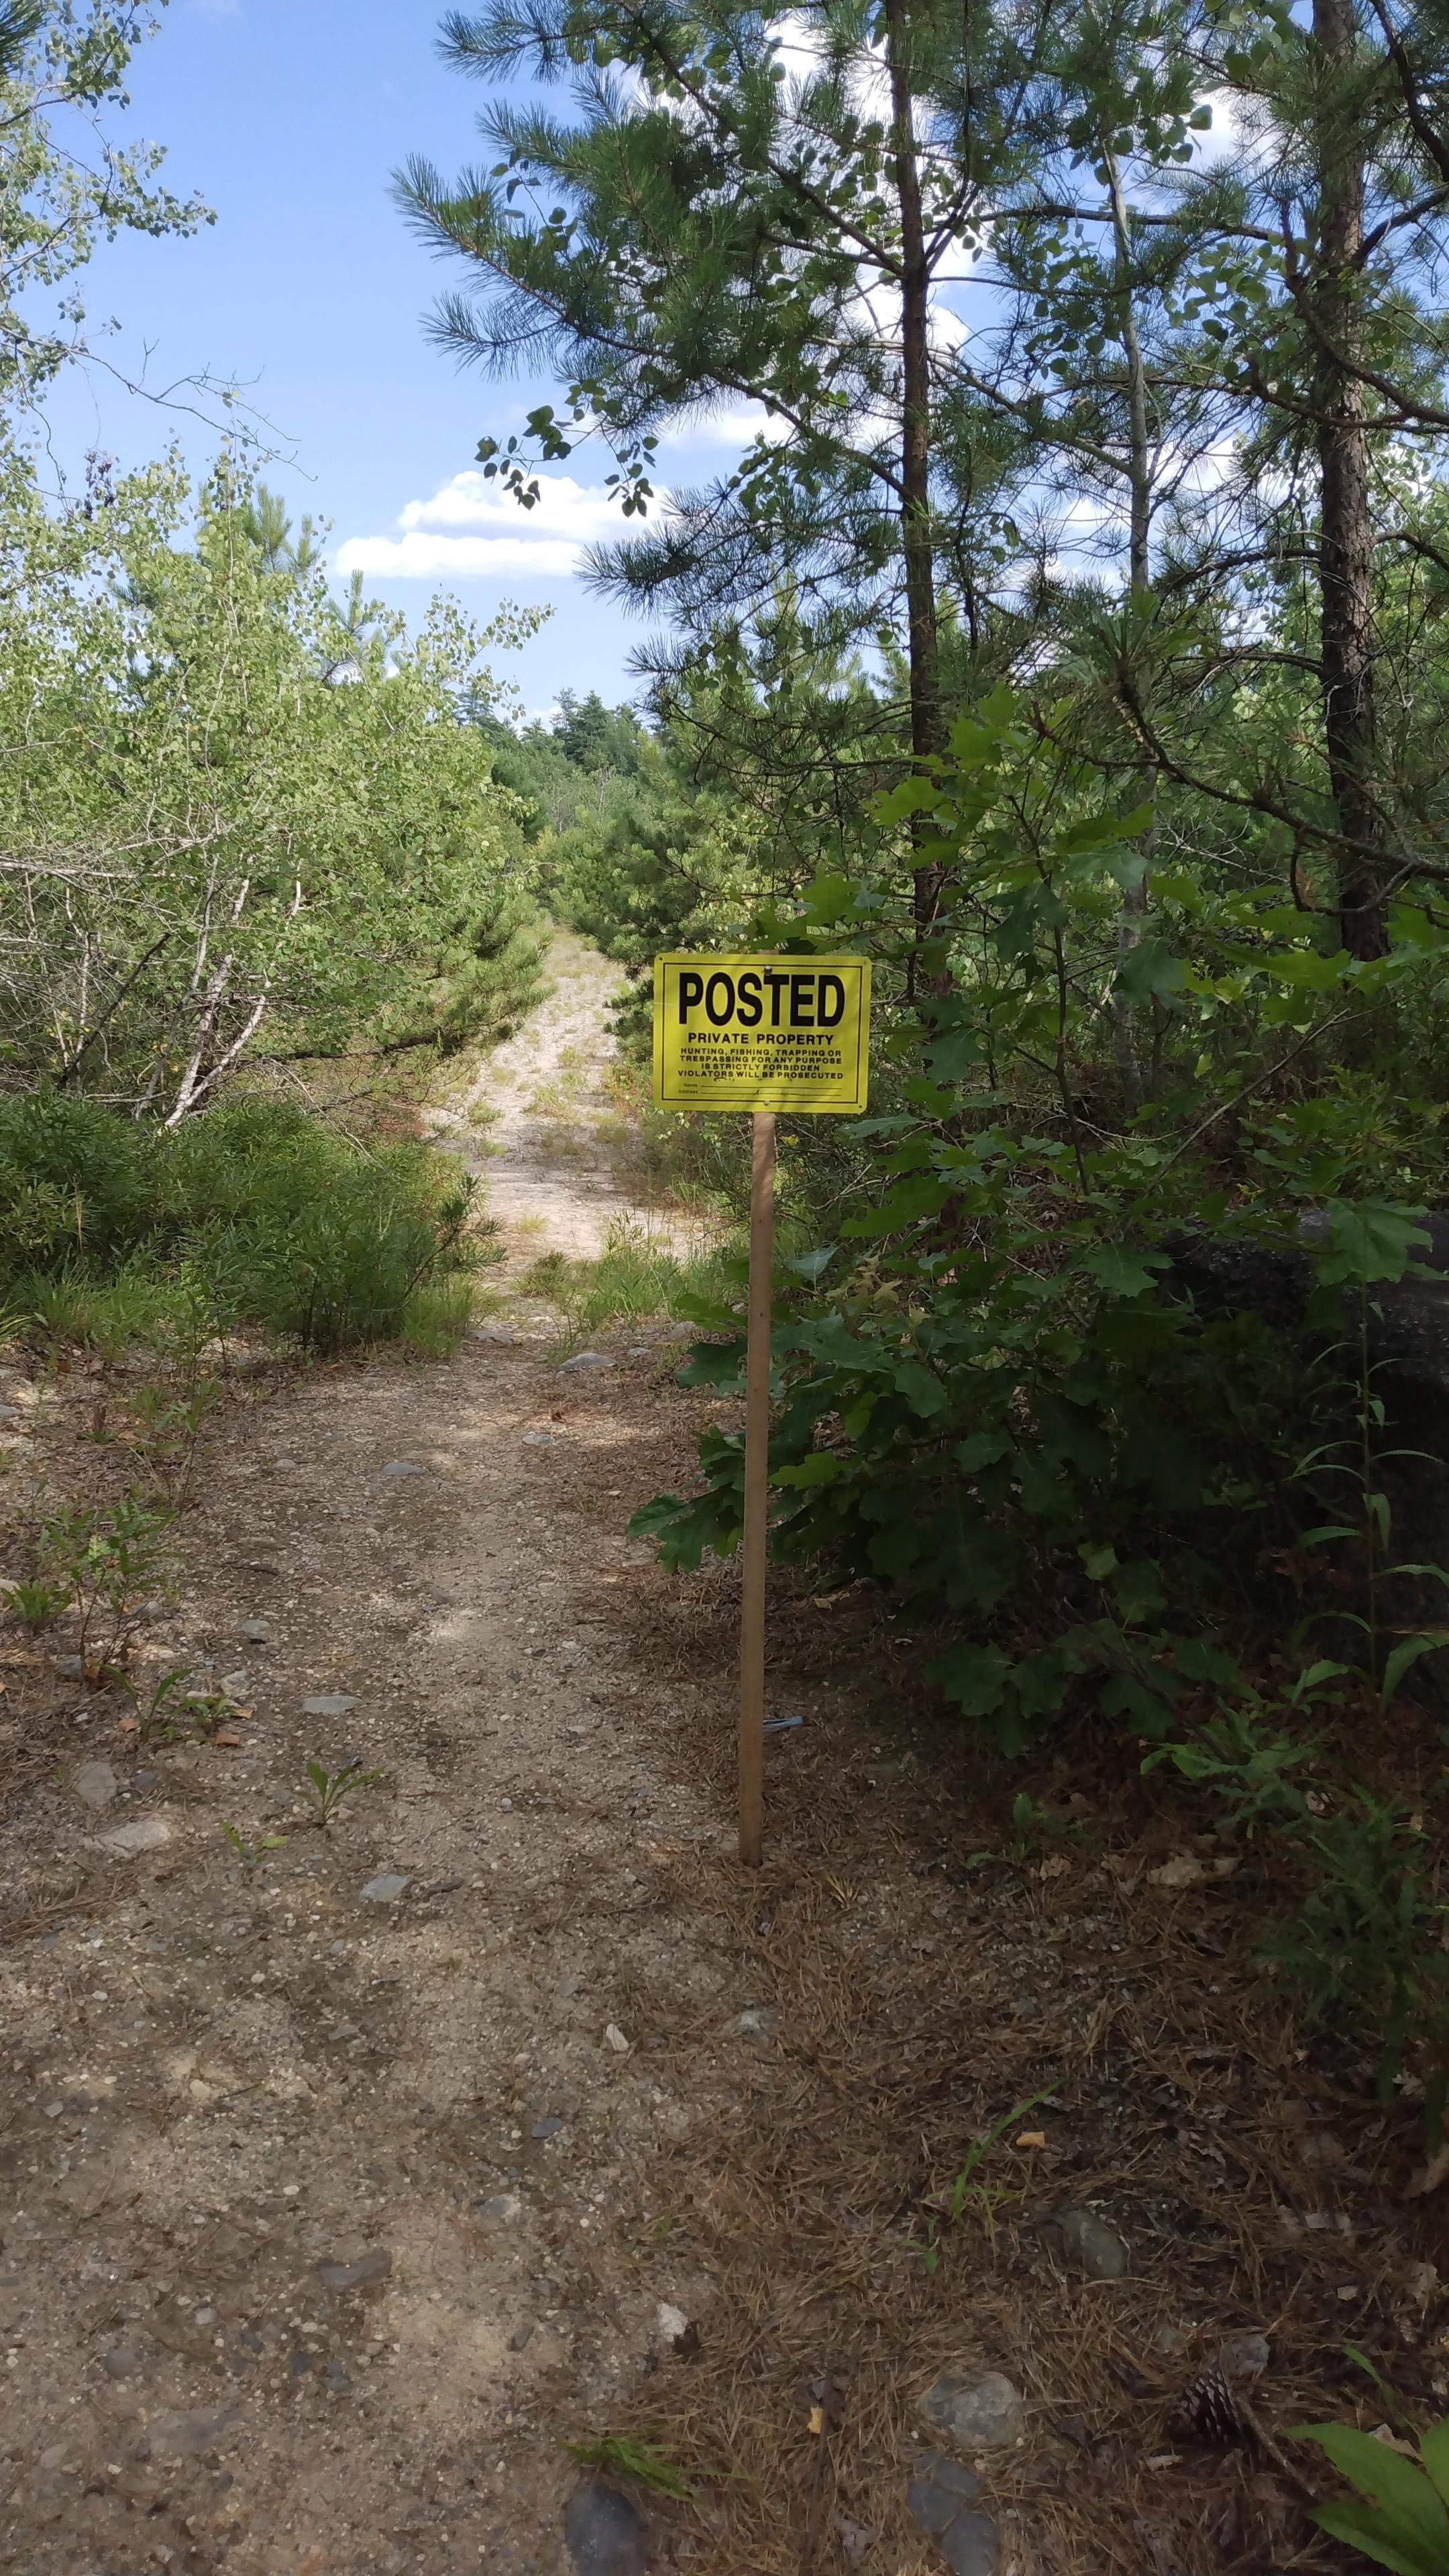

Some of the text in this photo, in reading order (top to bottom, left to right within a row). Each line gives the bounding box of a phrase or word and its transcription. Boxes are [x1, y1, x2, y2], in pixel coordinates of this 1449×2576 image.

[679, 972, 845, 1027] POSTED
[688, 1032, 834, 1045] PRIVATE PROPERTY
[731, 1049, 773, 1057] FISHING,
